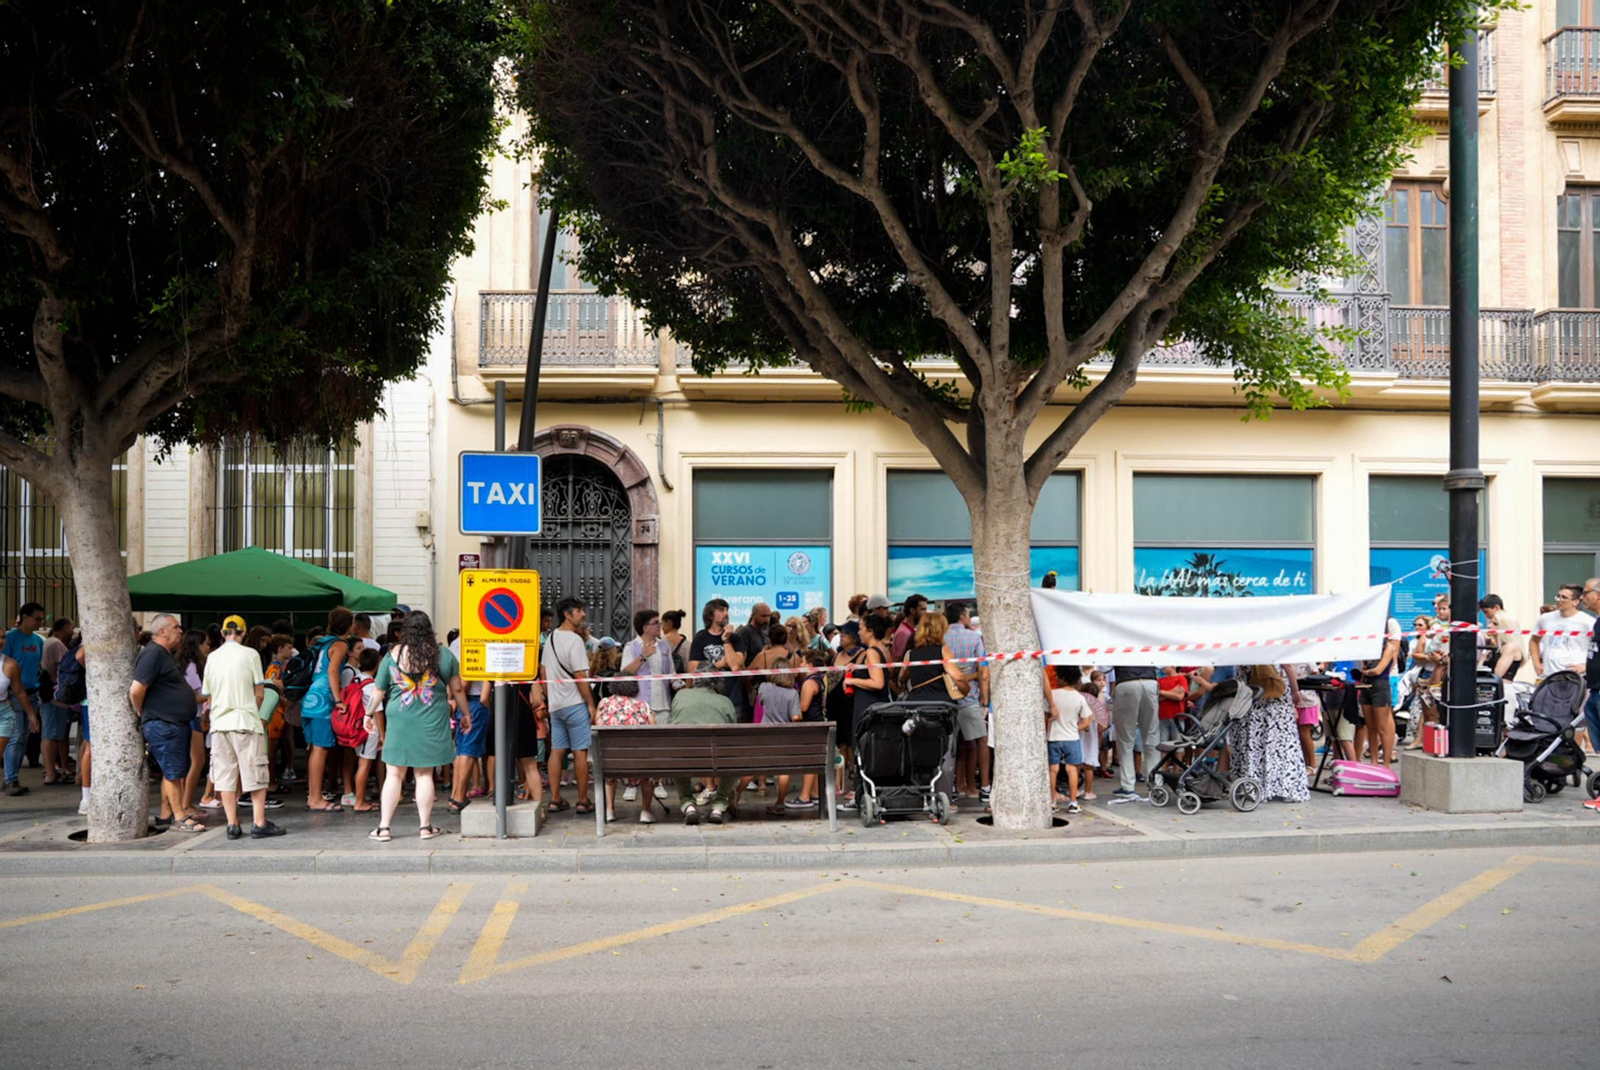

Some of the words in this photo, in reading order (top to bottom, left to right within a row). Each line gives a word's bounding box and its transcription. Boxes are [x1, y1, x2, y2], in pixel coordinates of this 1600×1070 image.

[467, 481, 535, 505] TAXI
[640, 525, 651, 534] 74
[711, 551, 751, 565] XXVI
[711, 565, 753, 575] CURSOS
[754, 565, 767, 575] de
[711, 575, 767, 586] VERANO
[1140, 568, 1157, 588] La
[1161, 568, 1195, 589] UAL
[1197, 571, 1229, 588] más
[1232, 575, 1269, 588] cerca
[1272, 568, 1291, 587] de
[1293, 571, 1307, 587] ti
[724, 596, 764, 604] verano
